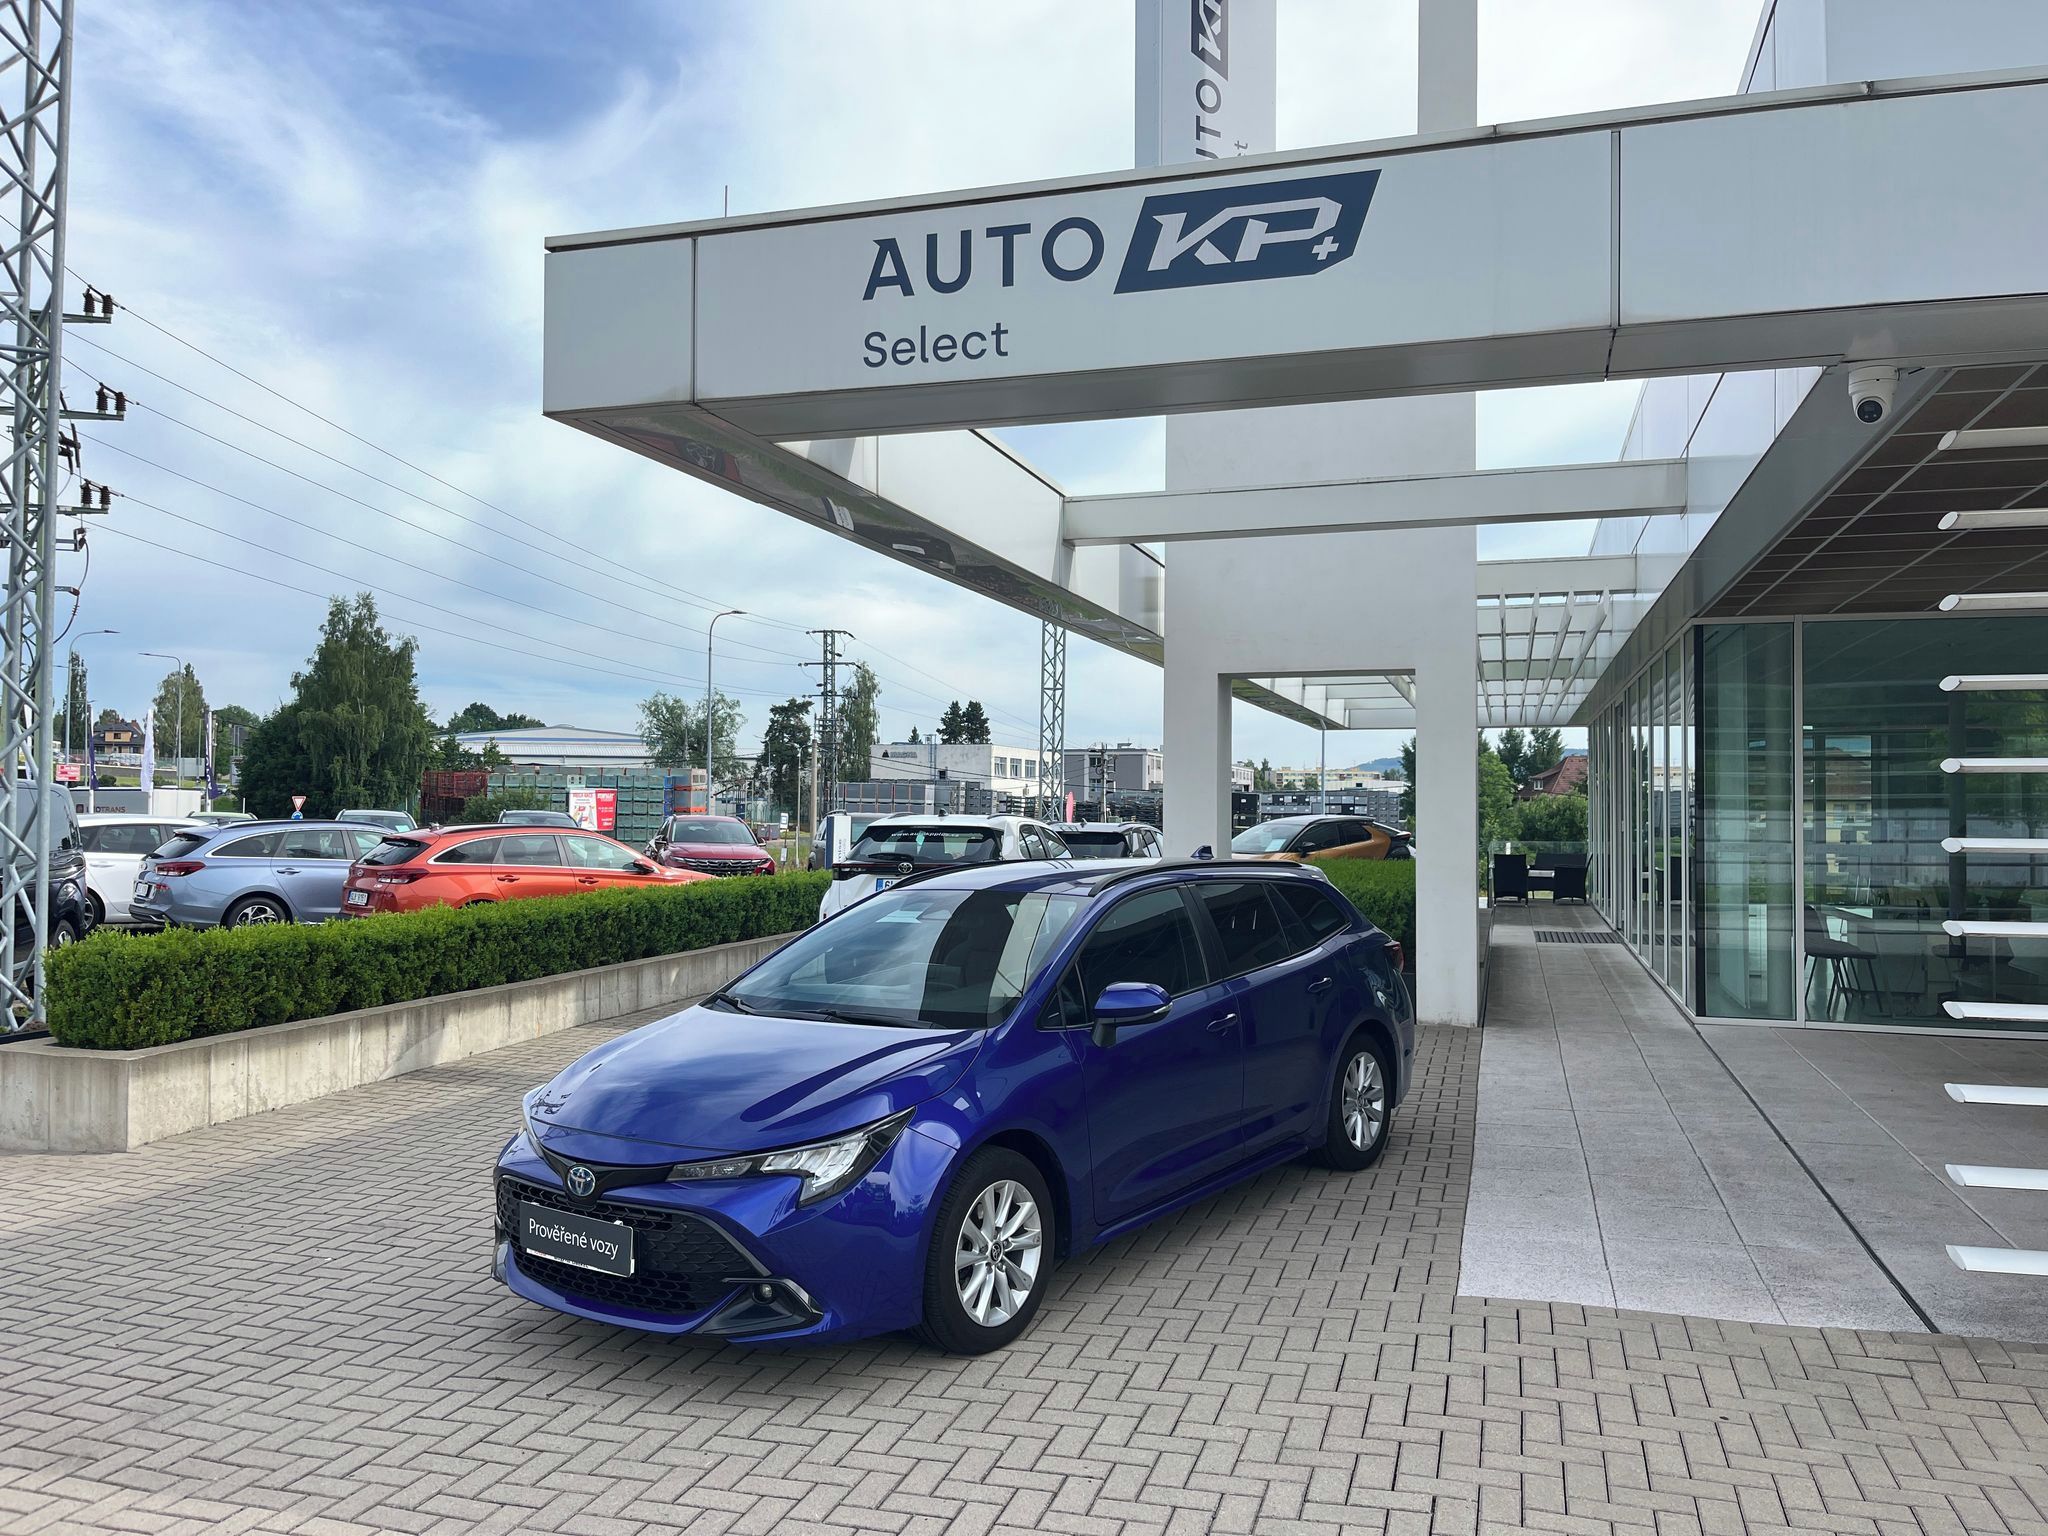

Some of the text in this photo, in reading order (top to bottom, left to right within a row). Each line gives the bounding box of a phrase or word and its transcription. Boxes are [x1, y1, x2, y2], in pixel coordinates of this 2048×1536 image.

[862, 216, 1105, 301] AUTO
[862, 322, 1009, 368] Select
[529, 1217, 619, 1260] Prověřené vozy
